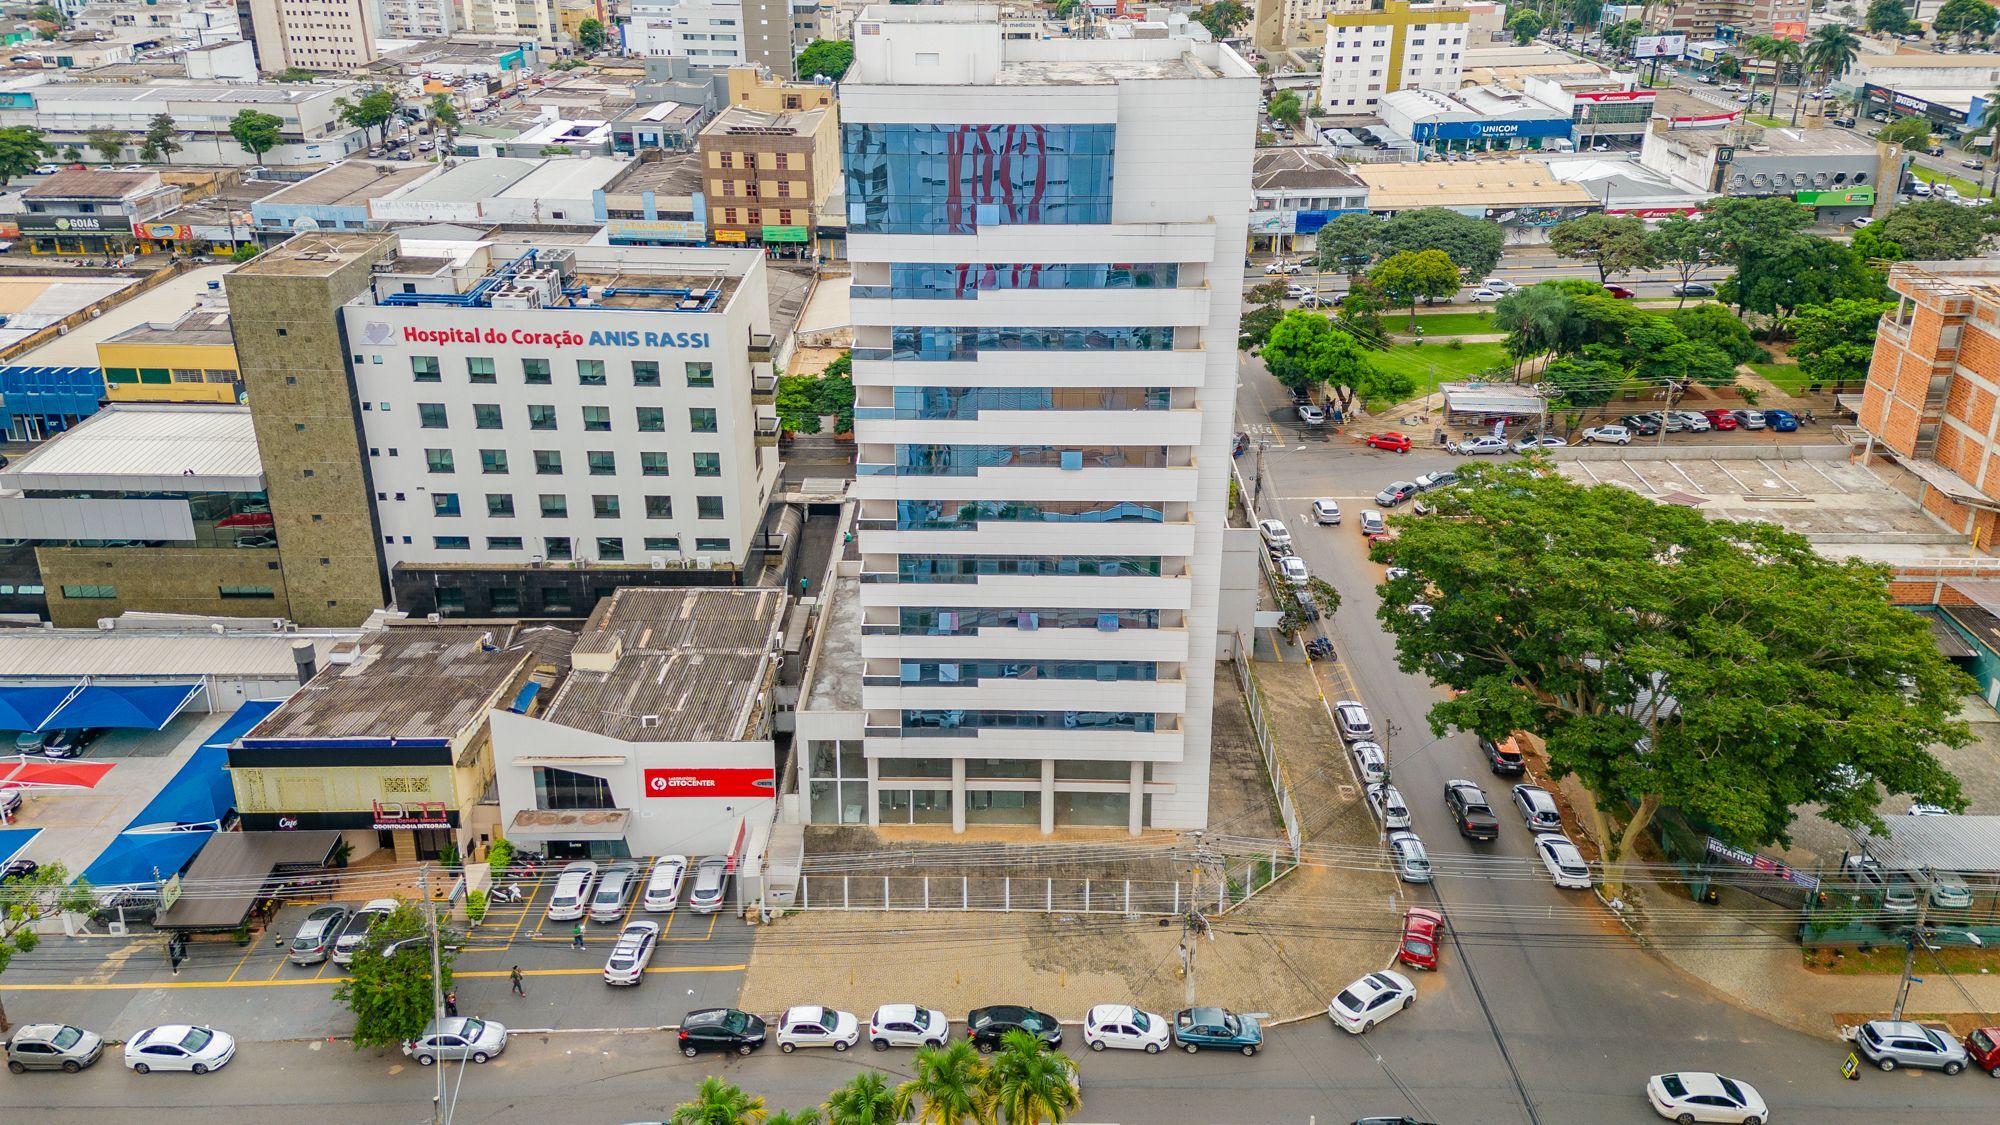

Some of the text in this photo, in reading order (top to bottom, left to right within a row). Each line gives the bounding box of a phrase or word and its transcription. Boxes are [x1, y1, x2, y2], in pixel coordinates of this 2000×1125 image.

[1482, 124, 1519, 133] UNICOM
[404, 326, 710, 349] Hospital do Coração ANIS RASSI
[1709, 843, 1753, 865] ROTATIVO
